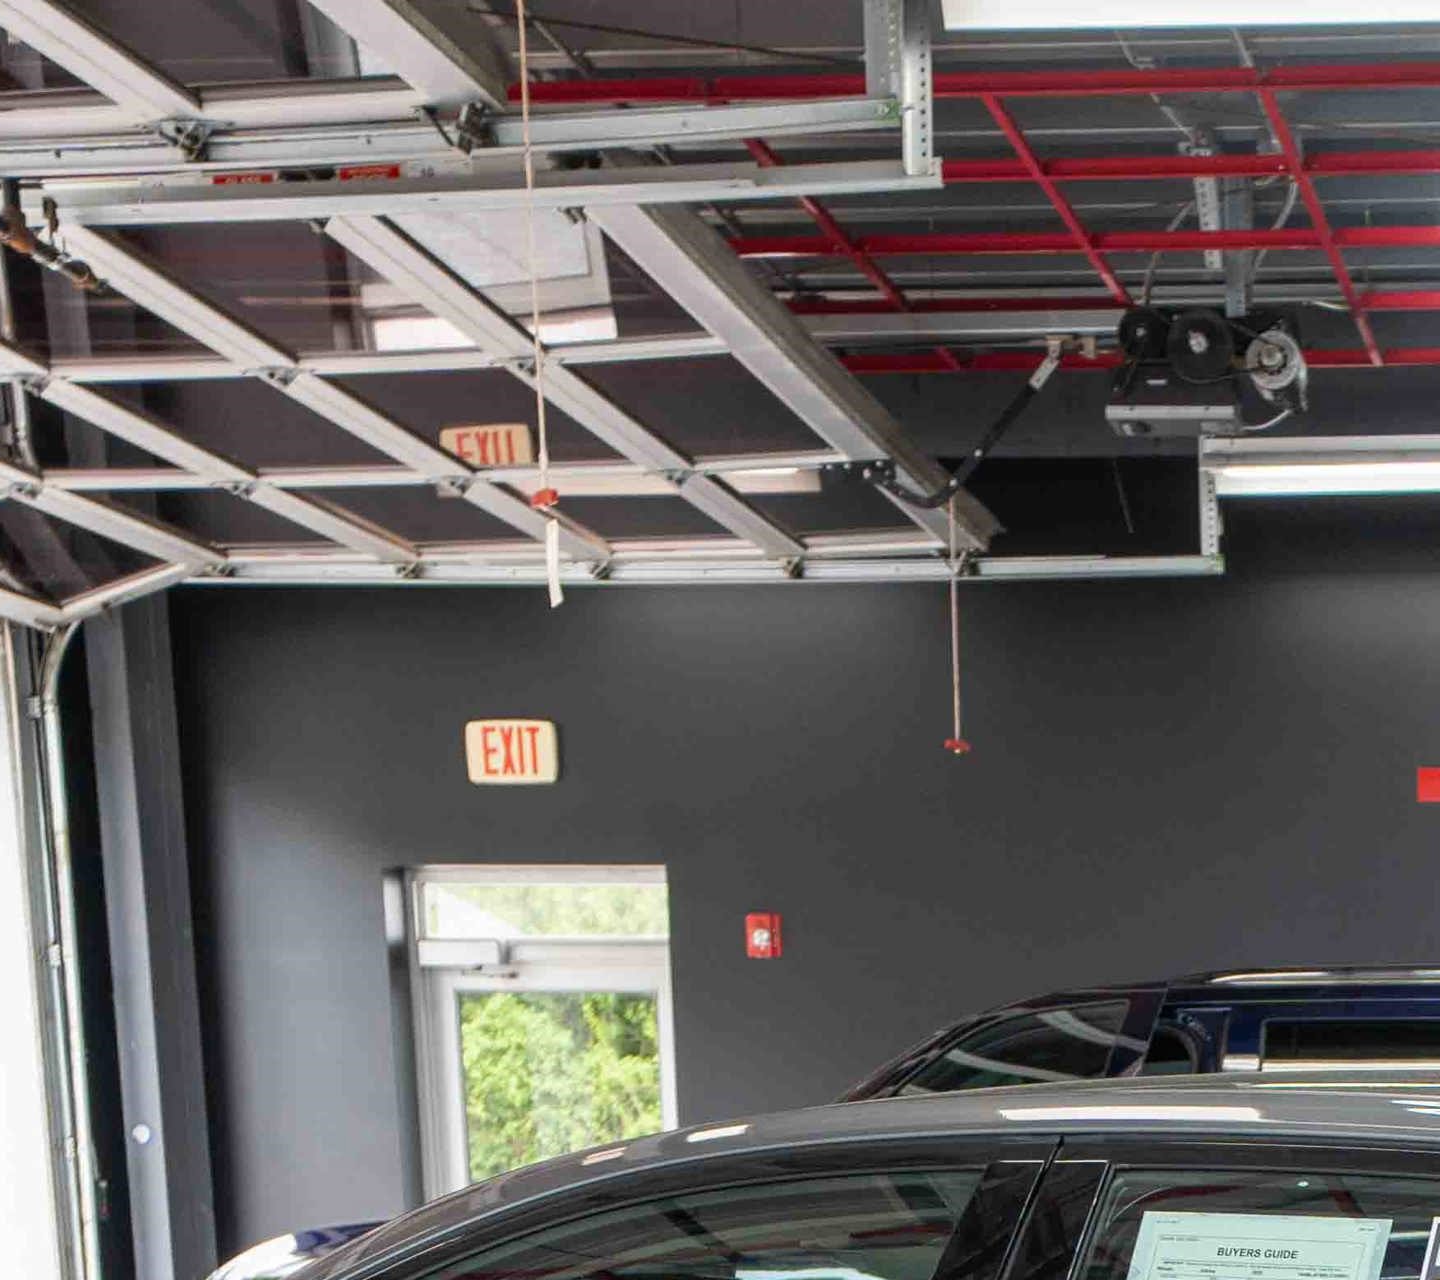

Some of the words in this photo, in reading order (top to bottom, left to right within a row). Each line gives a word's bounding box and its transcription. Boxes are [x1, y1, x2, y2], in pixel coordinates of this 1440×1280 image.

[481, 726, 540, 776] EXIT
[1217, 1247, 1261, 1259] BUYERS
[1264, 1249, 1299, 1260] GUIDE
